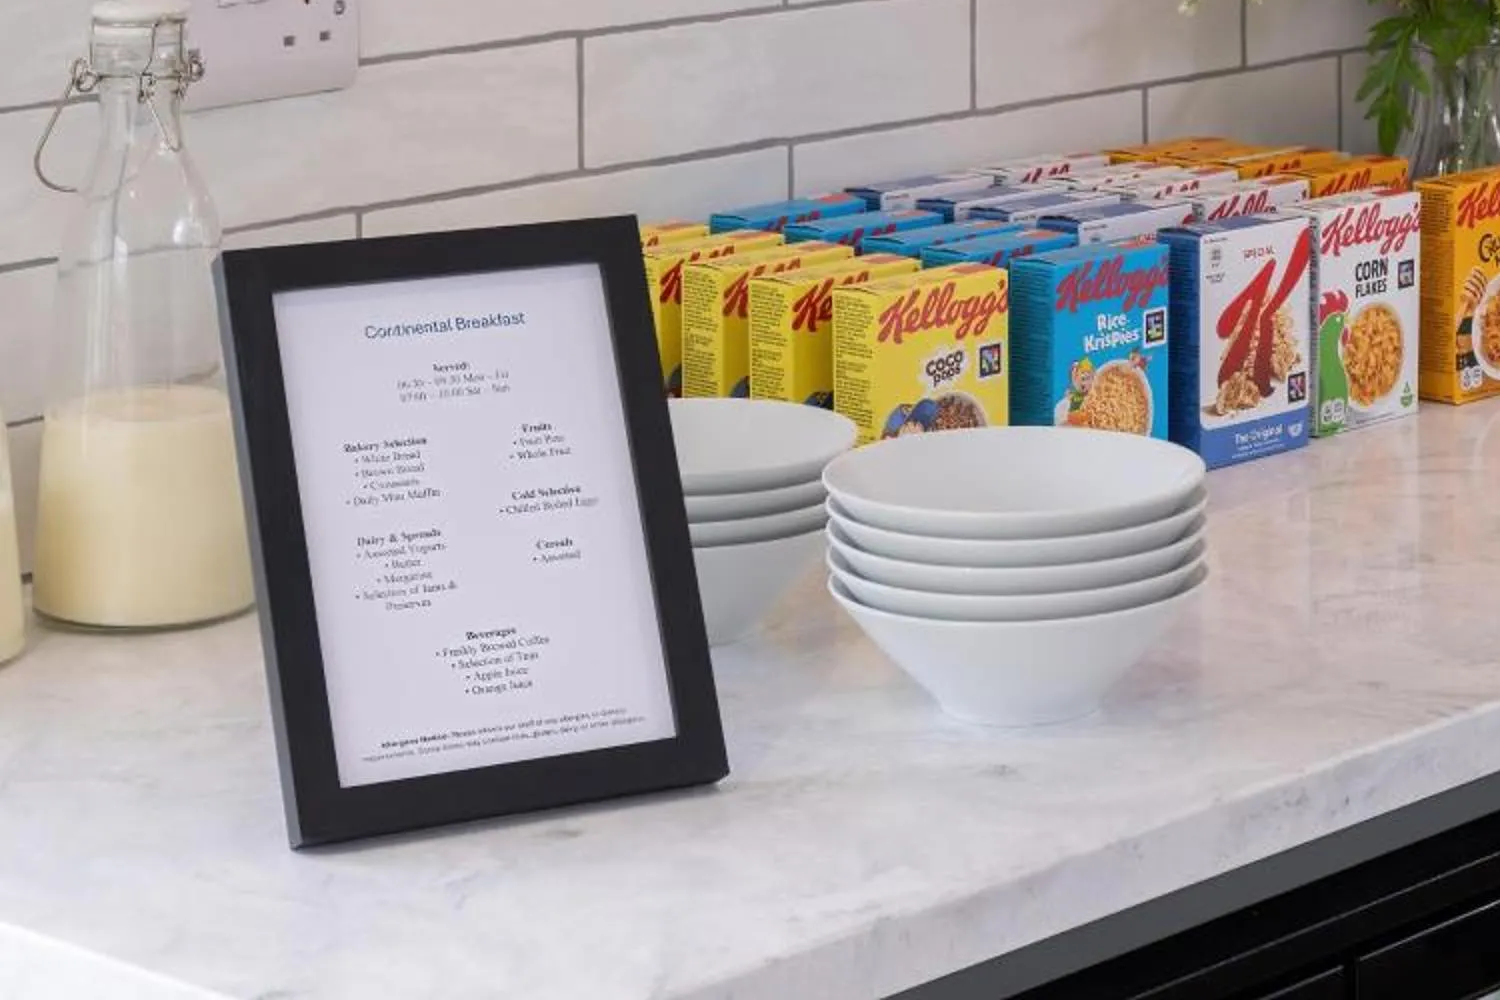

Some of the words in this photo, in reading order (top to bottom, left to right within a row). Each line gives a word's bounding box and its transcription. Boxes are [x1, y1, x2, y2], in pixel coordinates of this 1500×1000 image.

[1321, 202, 1420, 256] Kellogg's
[1355, 257, 1389, 281] CORN
[1355, 278, 1387, 298] FLAKES
[877, 279, 1008, 344] Kellogg's
[1097, 313, 1128, 330] Rice
[364, 318, 453, 339] Continental
[455, 311, 527, 331] Breakfast
